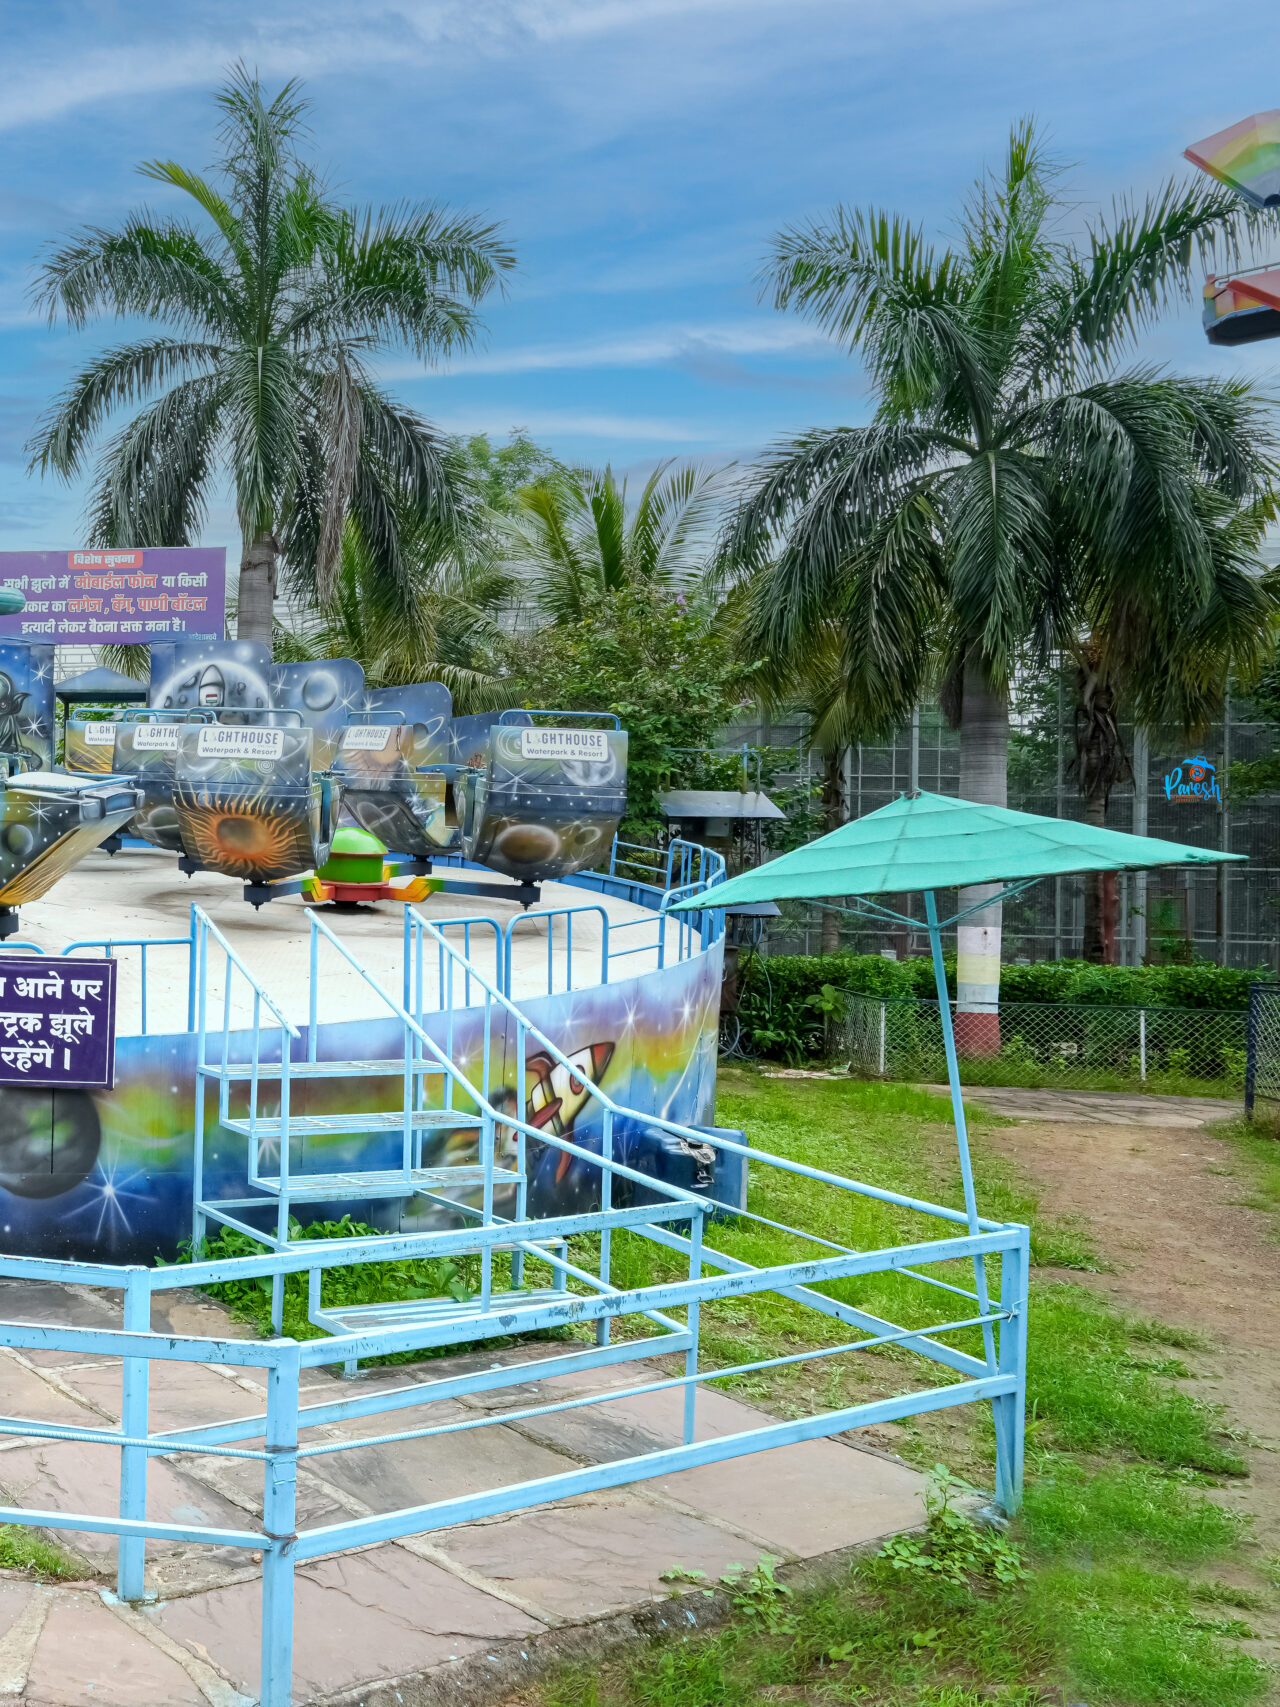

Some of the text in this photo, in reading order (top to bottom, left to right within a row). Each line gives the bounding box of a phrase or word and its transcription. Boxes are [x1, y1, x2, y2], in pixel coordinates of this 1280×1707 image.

[58, 574, 71, 590] में
[74, 571, 125, 590] मोबाईल
[126, 570, 158, 589] फोन
[162, 575, 176, 588] या
[177, 572, 208, 588] किसी
[51, 601, 66, 612] का
[67, 594, 103, 612] लगेज
[137, 593, 168, 611] पाणी
[21, 618, 56, 634] इत्यादी
[58, 618, 87, 633] लेकर
[88, 617, 118, 633] बैठना
[145, 621, 171, 632] मना
[202, 747, 241, 755] Waterpark
[527, 748, 568, 756] Waterpark
[14, 971, 64, 999] आने
[71, 979, 103, 1001] पर
[49, 1007, 95, 1044] झूले
[0, 1040, 54, 1072] रहेंगे
